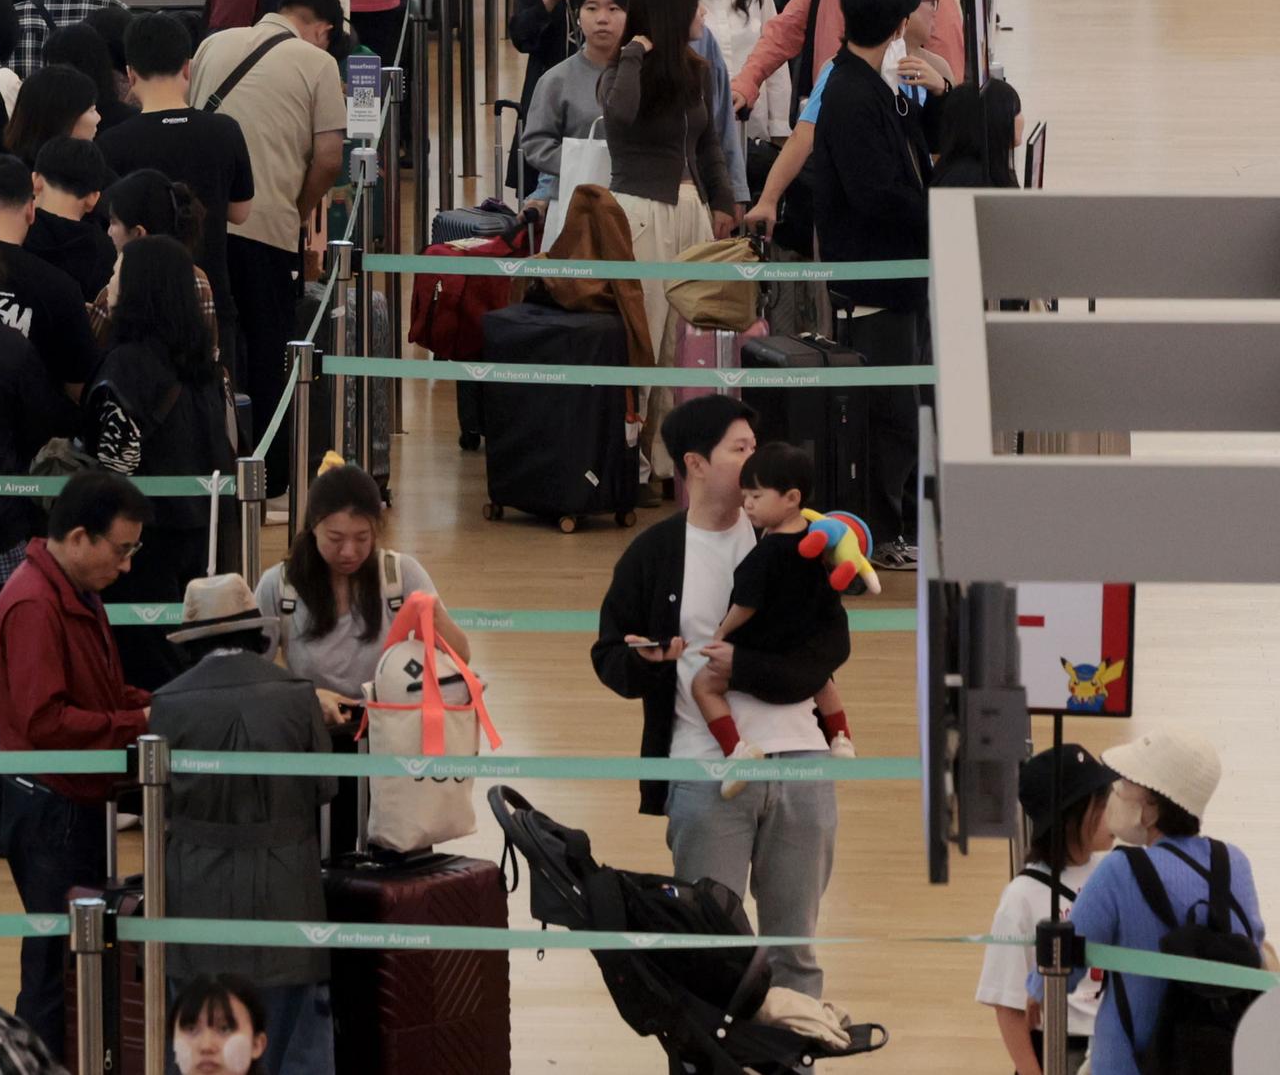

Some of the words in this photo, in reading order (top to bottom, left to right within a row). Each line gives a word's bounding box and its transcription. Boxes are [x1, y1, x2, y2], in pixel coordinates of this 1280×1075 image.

[524, 266, 559, 278] Incheon
[562, 266, 593, 278] Airport
[763, 268, 798, 279] Incheon
[801, 268, 833, 279] Airport
[493, 370, 529, 382] Incheon
[532, 370, 566, 382] Airport
[745, 374, 785, 385] Incheon
[787, 374, 820, 385] Airport
[3, 482, 41, 495] Airport
[476, 616, 515, 629] Airport
[180, 758, 221, 771] Airport
[433, 763, 478, 776] Incheon
[480, 763, 521, 776] Airport
[736, 765, 780, 779] Incheon
[783, 765, 824, 779] Airport
[337, 933, 384, 946] Incheon
[387, 933, 430, 946] Airport
